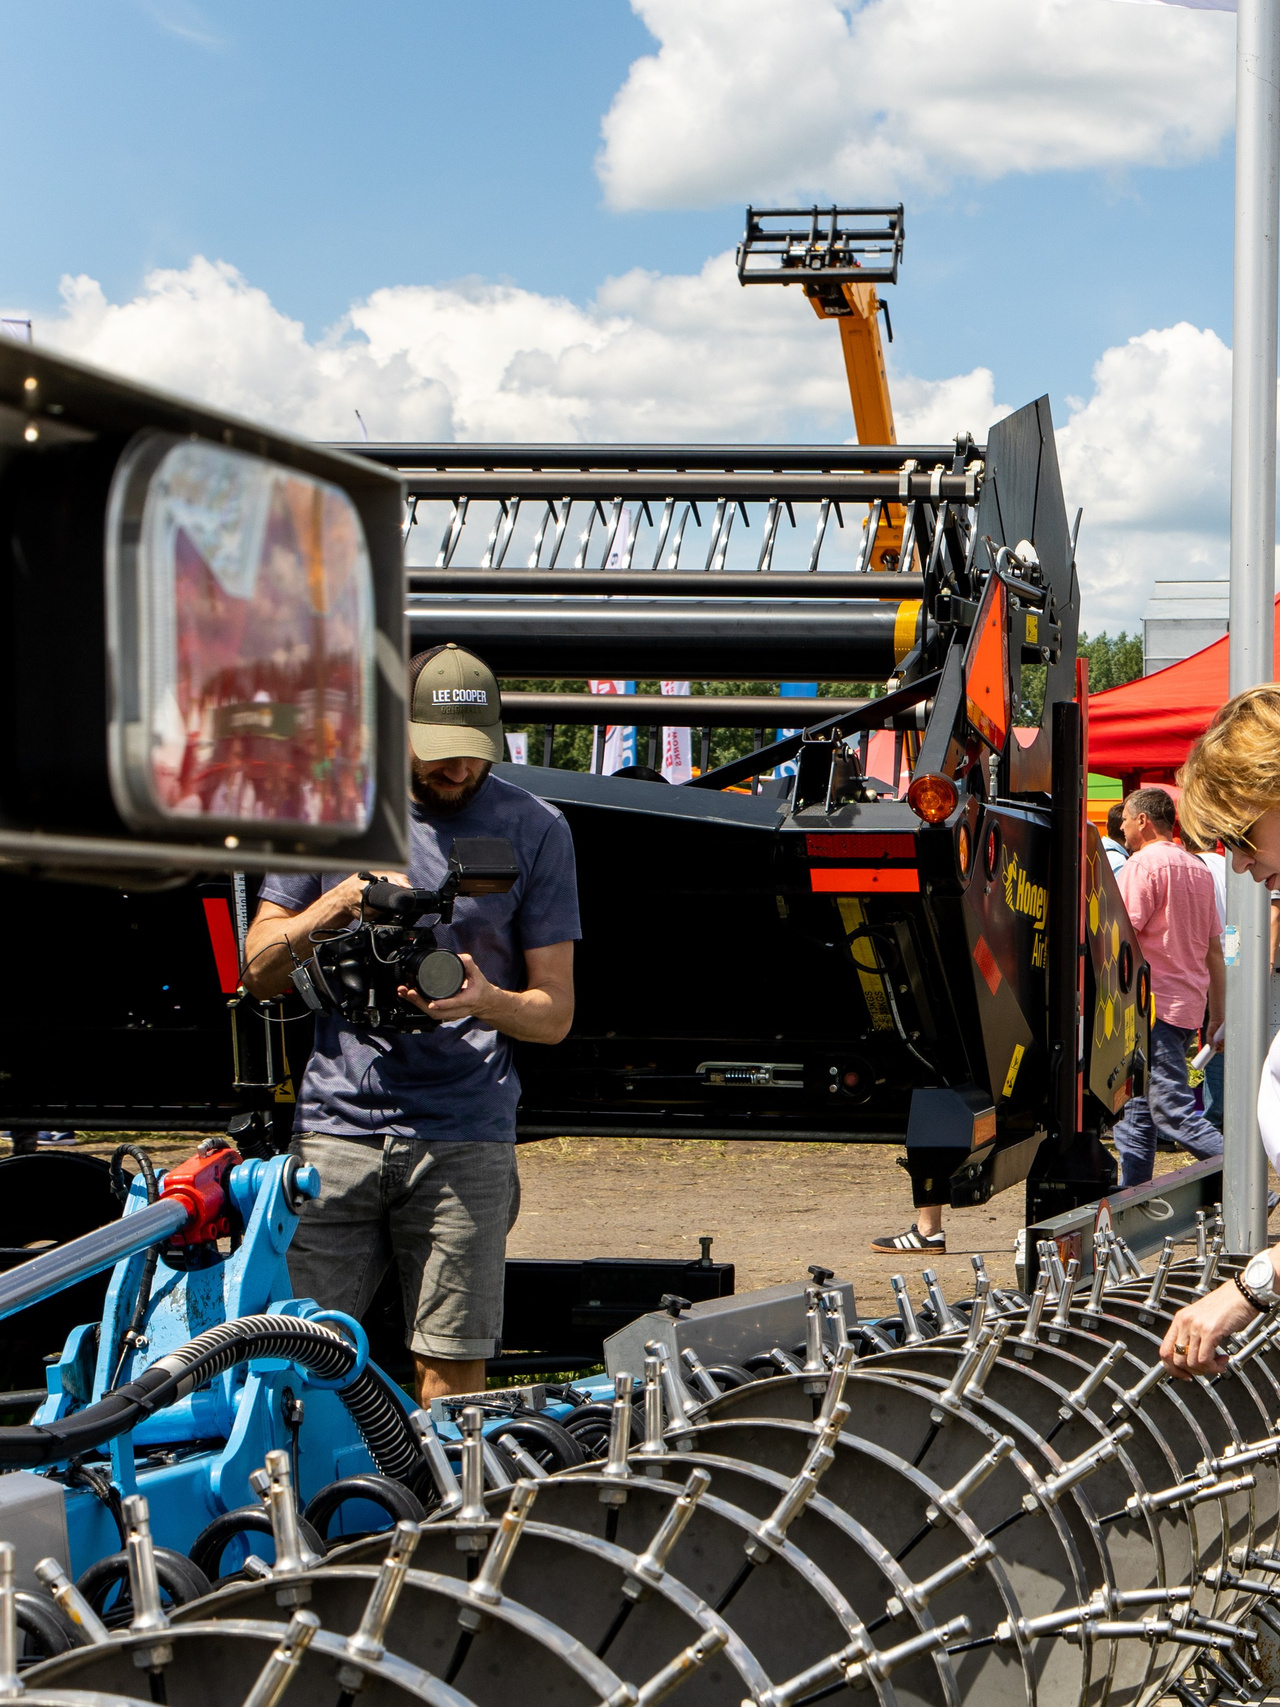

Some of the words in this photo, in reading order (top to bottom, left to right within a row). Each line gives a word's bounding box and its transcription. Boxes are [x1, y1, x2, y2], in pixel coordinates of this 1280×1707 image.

[432, 690, 451, 703] LEE
[453, 689, 487, 703] COOPER
[1016, 868, 1049, 930] Honey
